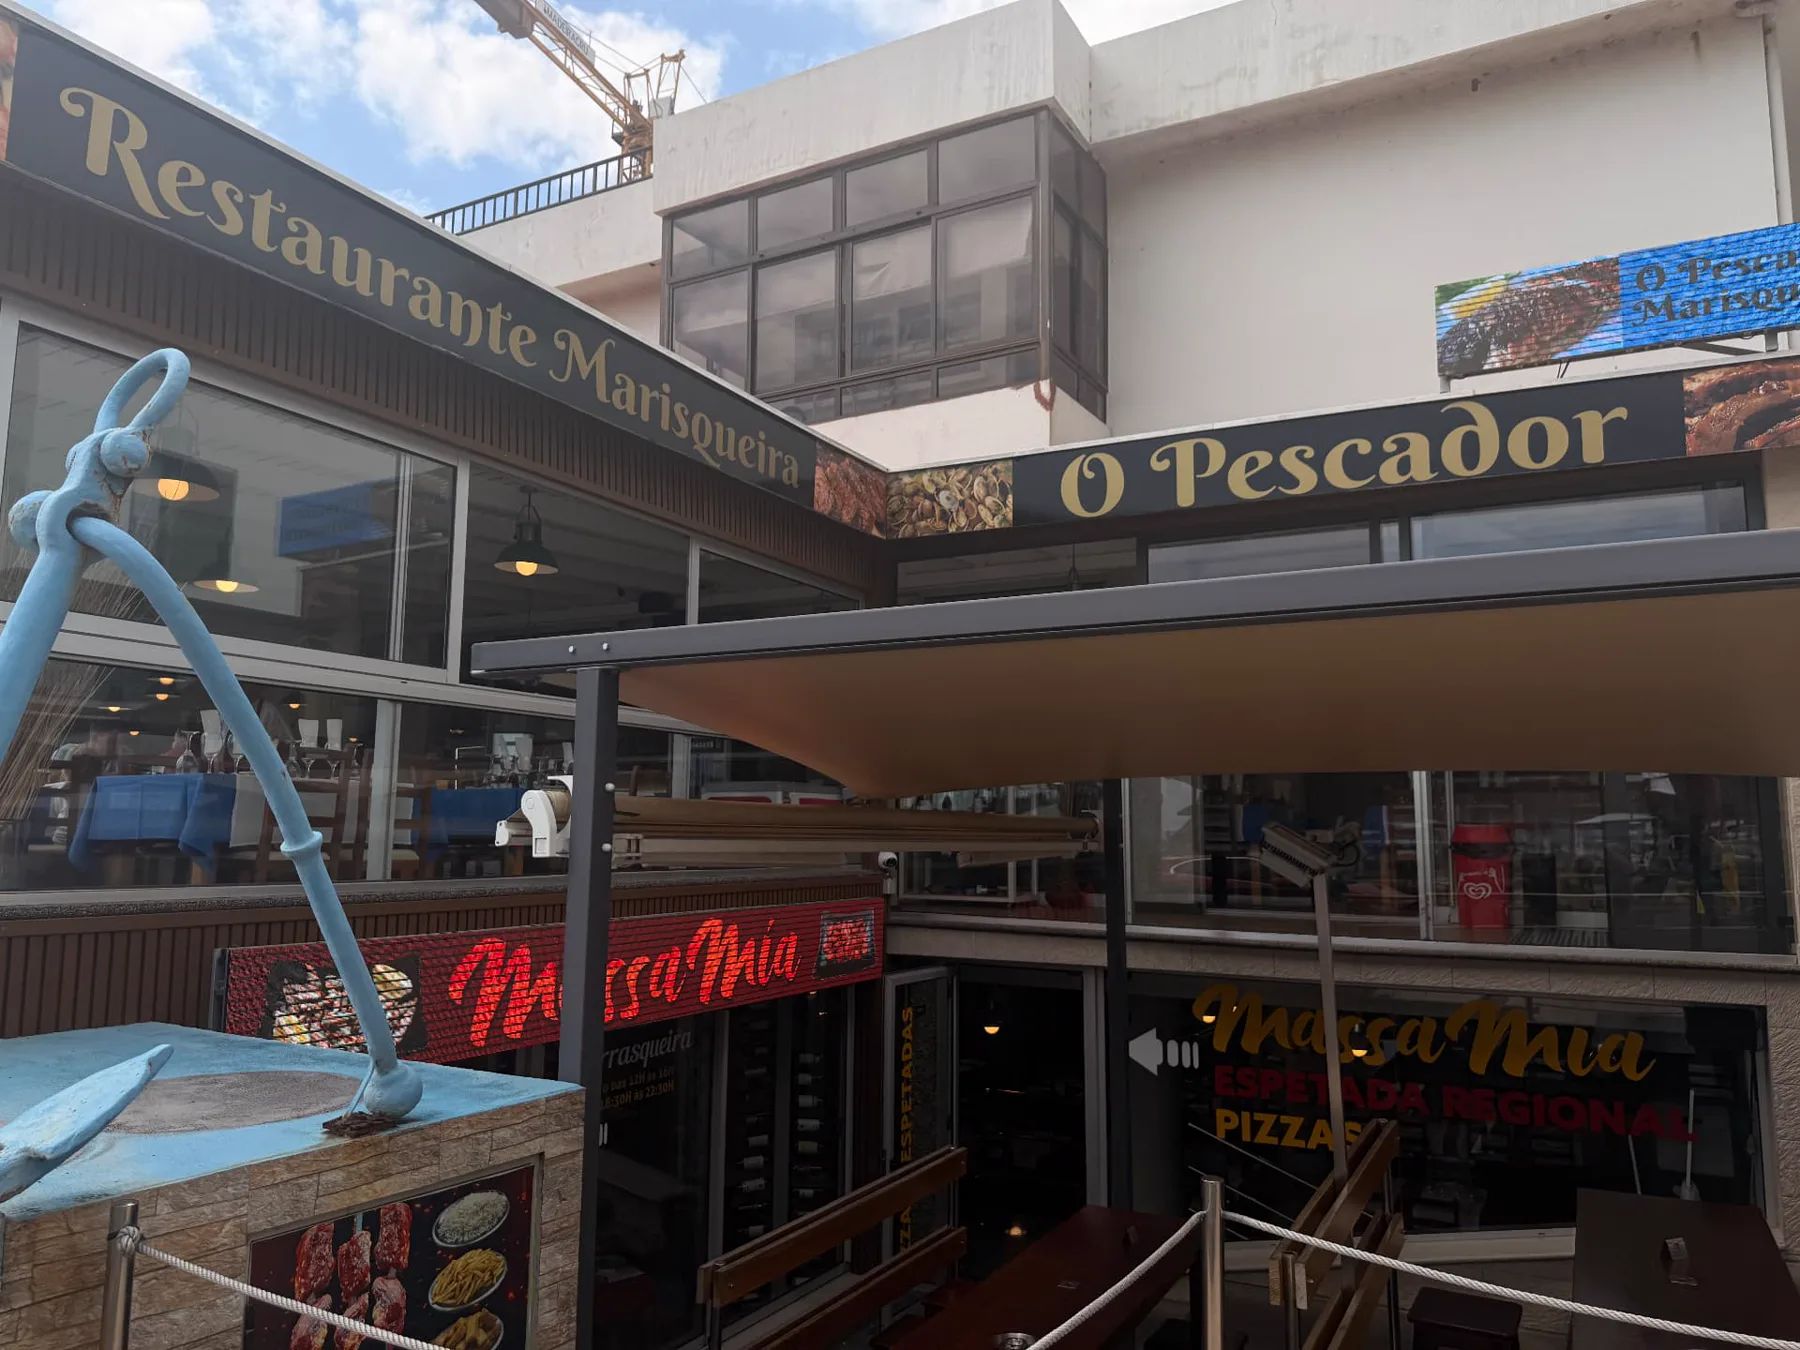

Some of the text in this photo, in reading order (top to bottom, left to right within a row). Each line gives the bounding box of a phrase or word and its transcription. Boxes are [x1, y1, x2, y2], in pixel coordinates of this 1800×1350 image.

[59, 87, 800, 489] Restaurante Marisqueira
[1636, 264, 1667, 291] O
[1060, 401, 1628, 518] O Pescador
[448, 937, 688, 1047] Mssa
[1192, 983, 1657, 1082] Massa Mia
[1213, 1064, 1700, 1142] ESPETADA REGIONAL
